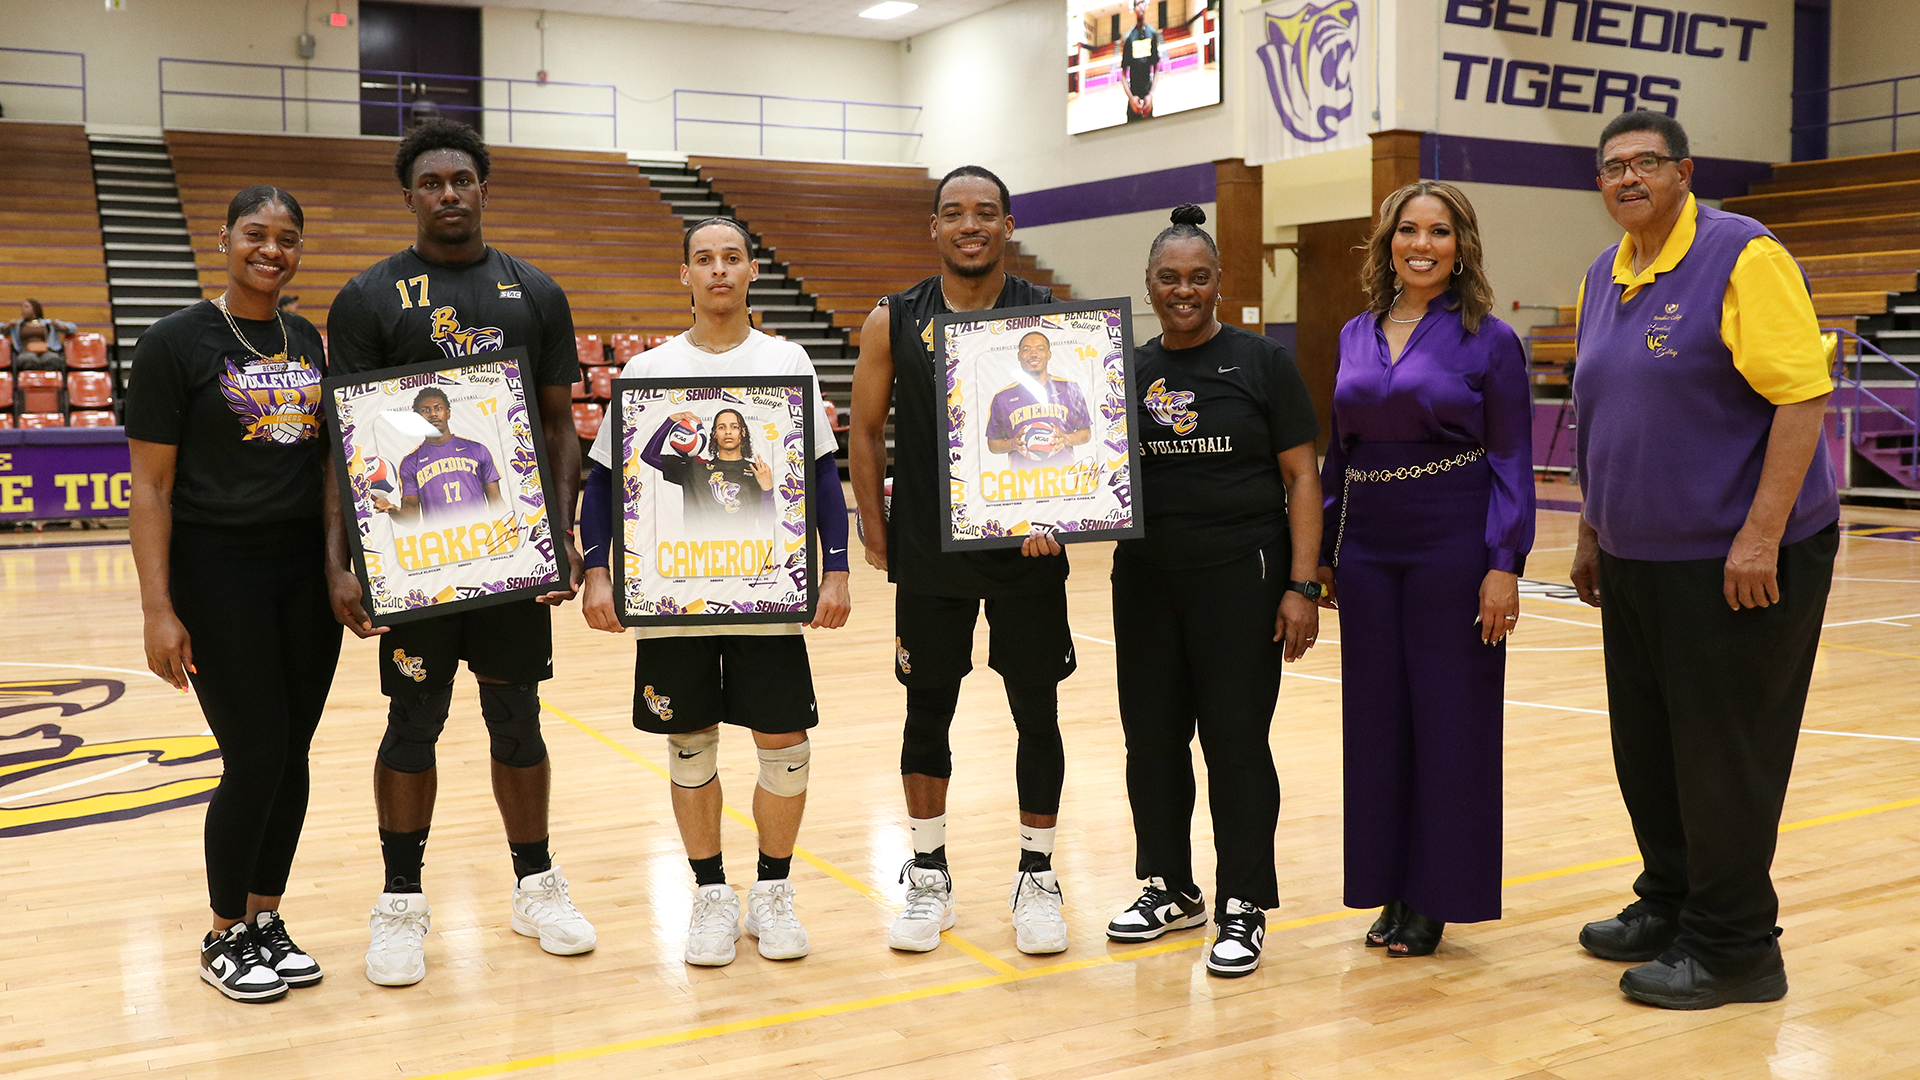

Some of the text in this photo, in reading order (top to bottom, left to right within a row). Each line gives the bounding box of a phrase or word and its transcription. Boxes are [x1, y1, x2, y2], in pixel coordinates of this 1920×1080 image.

[1445, 0, 1768, 61] BENEDICT
[1443, 52, 1681, 119] TIGERS
[396, 274, 431, 309] 17
[1005, 316, 1041, 331] SENIOR
[1064, 310, 1103, 322] BENEDIC
[1071, 320, 1101, 331] College
[1106, 327, 1122, 349] SIA
[1074, 344, 1099, 361] 14
[461, 362, 502, 376] BENEDIC
[238, 369, 321, 389] VOLLEYBALL
[400, 373, 438, 391] SENIOR
[468, 376, 500, 385] College
[507, 378, 525, 401] SIA
[685, 387, 722, 401] SENIOR
[746, 386, 785, 399] BENEDIC
[476, 397, 498, 416] 17
[752, 396, 783, 408] College
[276, 414, 302, 422] TIGERS
[790, 405, 803, 428] SIA
[1009, 402, 1069, 430] BENEDICT
[763, 422, 779, 441] 3
[1147, 436, 1232, 455] VOLLEYBALL
[417, 457, 478, 489] BENEDICT
[980, 463, 1099, 501] CAMRON
[54, 472, 131, 511] TIG
[443, 481, 462, 503] 17
[395, 517, 519, 570] HAKAN
[657, 540, 773, 577] CAMERON
